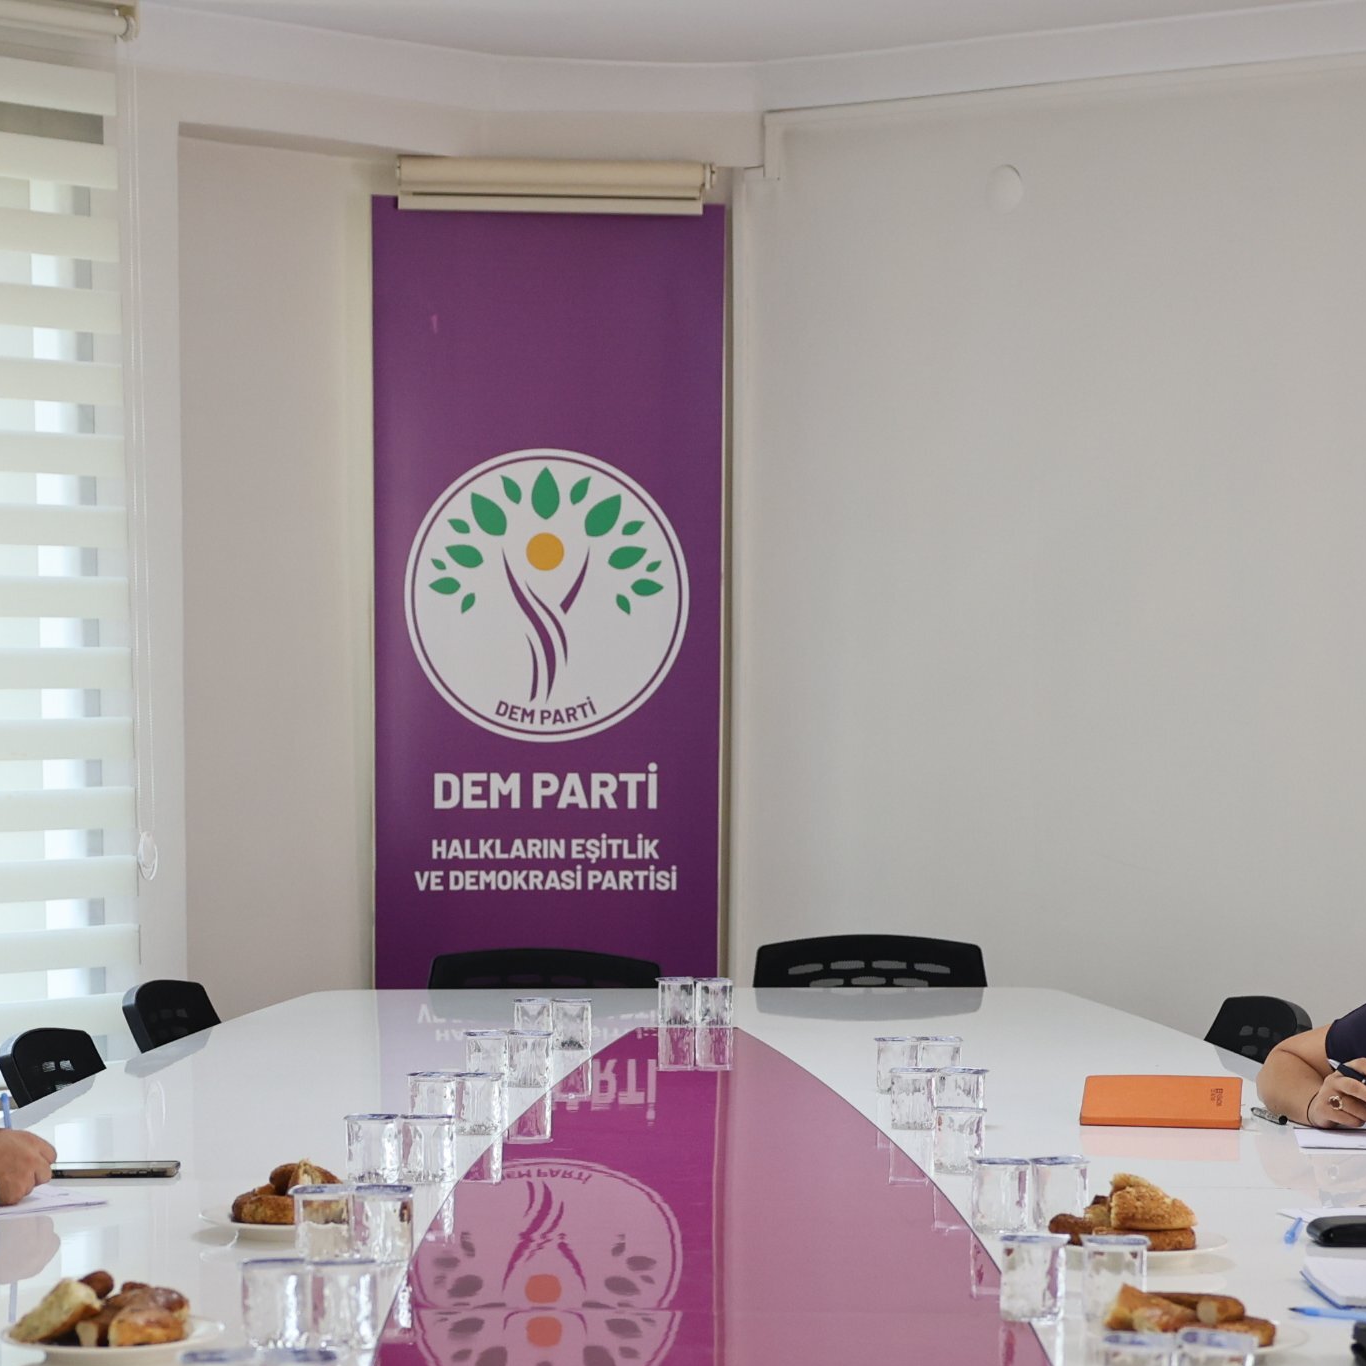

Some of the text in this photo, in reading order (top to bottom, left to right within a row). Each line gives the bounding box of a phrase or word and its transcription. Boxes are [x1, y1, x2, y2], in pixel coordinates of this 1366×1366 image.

[495, 696, 597, 725] DEM PARTİ
[434, 762, 658, 810] DEM PARTİ
[431, 832, 660, 864] HALKLARIN EŞİTLİK
[414, 864, 677, 891] VE DEMOKRASİ PARTİSİ
